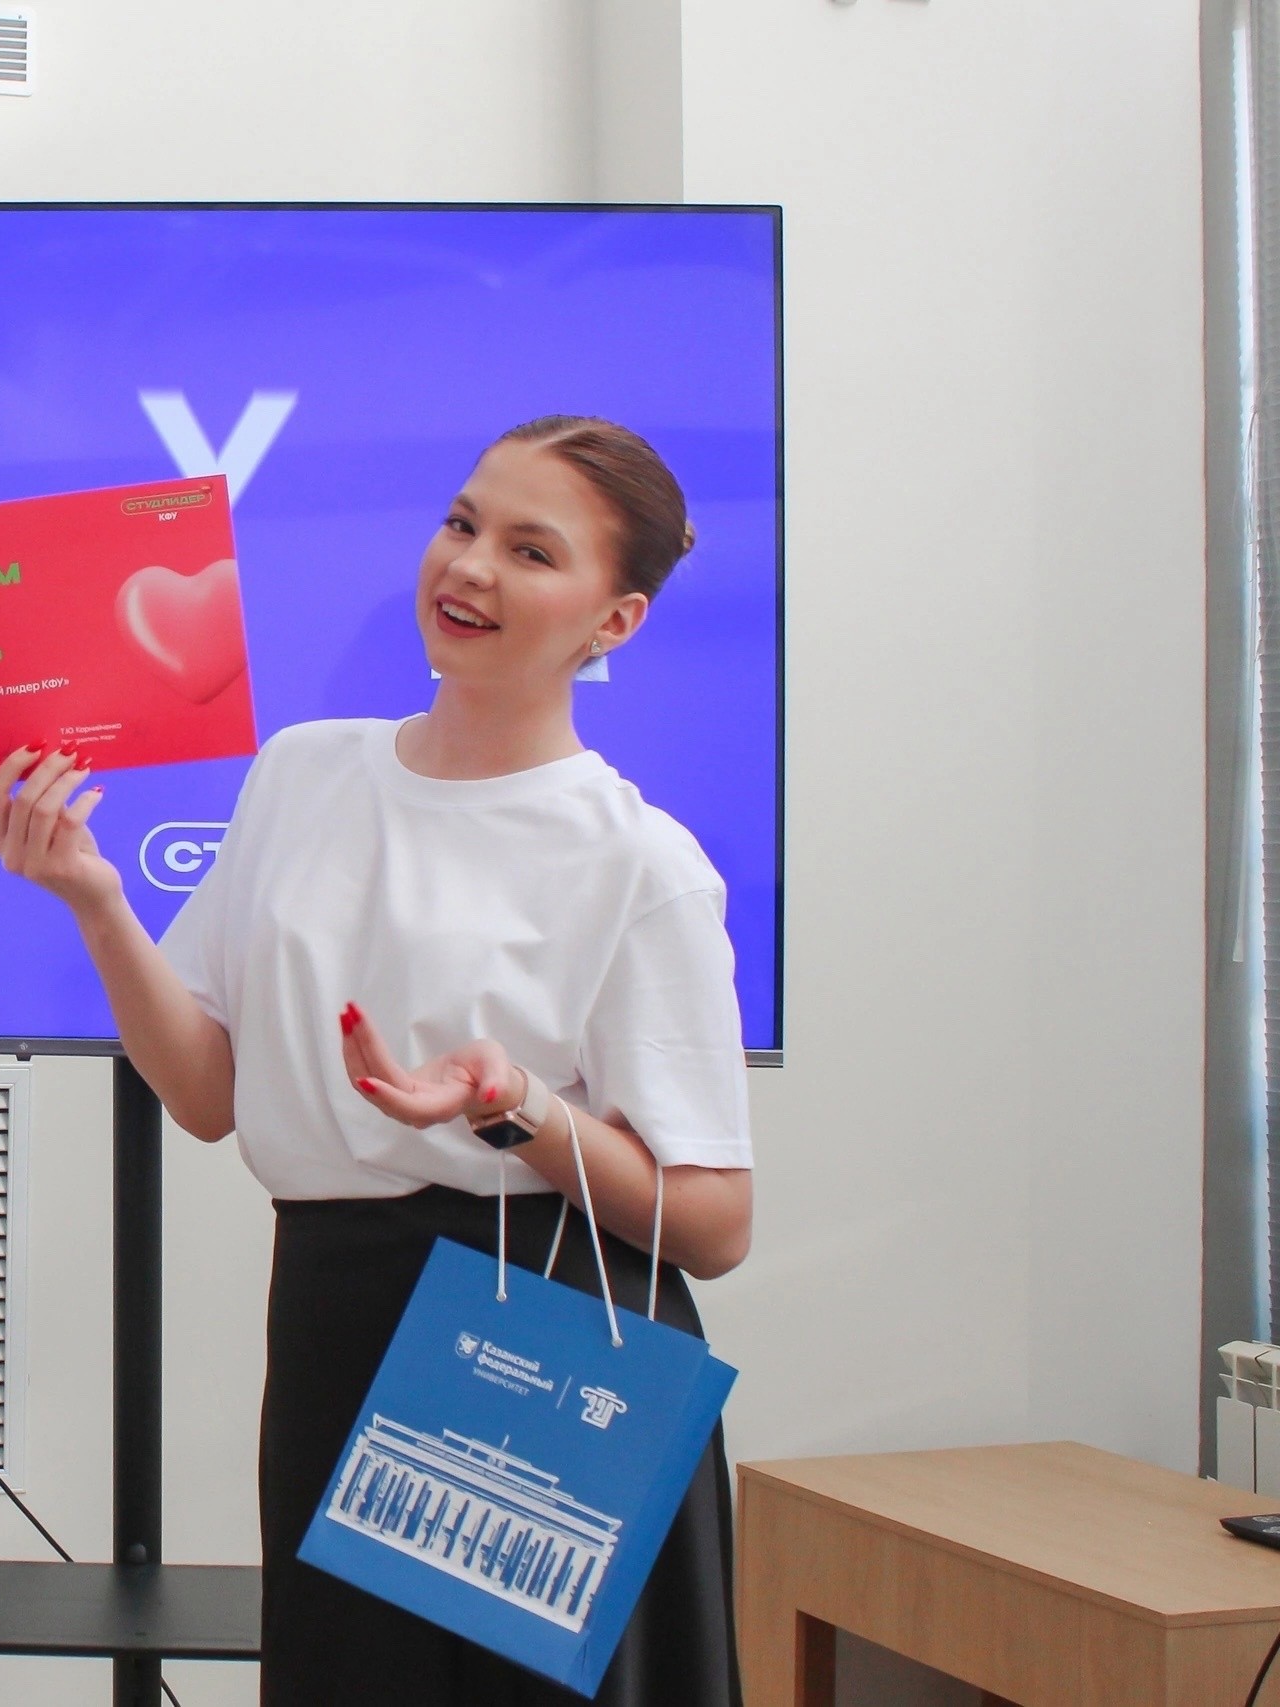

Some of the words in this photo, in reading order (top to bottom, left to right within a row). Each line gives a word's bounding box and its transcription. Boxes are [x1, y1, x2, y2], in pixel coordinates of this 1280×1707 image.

[158, 512, 178, 521] КФУ
[5, 682, 40, 697] лидер
[42, 676, 70, 690] КФУ»
[482, 1340, 541, 1373] Казанский
[477, 1353, 554, 1392] федеральный
